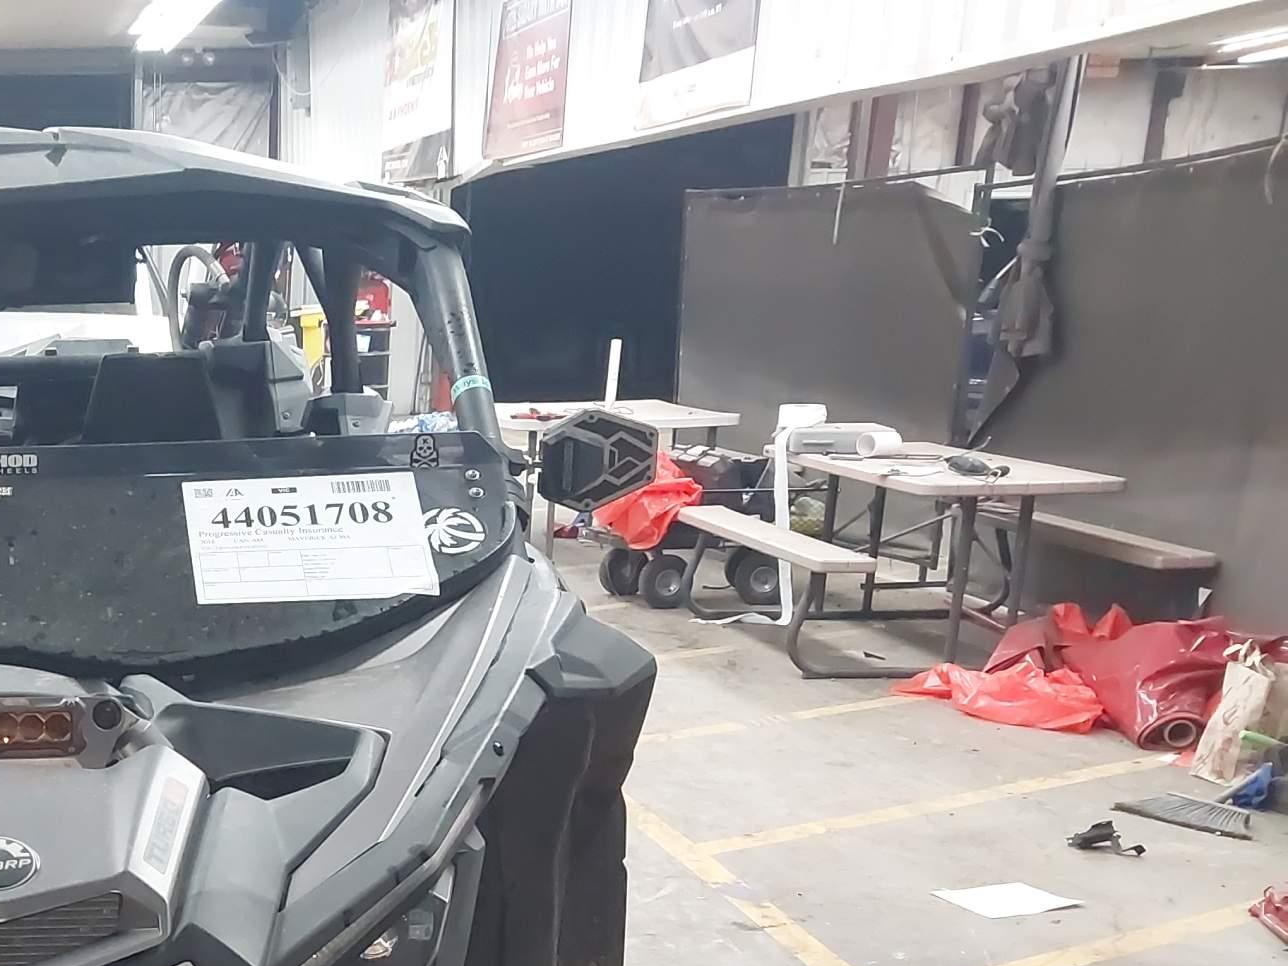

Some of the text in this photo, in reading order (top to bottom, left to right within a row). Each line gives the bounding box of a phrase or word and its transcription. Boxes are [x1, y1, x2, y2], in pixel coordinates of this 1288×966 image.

[211, 500, 394, 529] 44051708
[198, 526, 343, 539] Progressive Casualty Insurance
